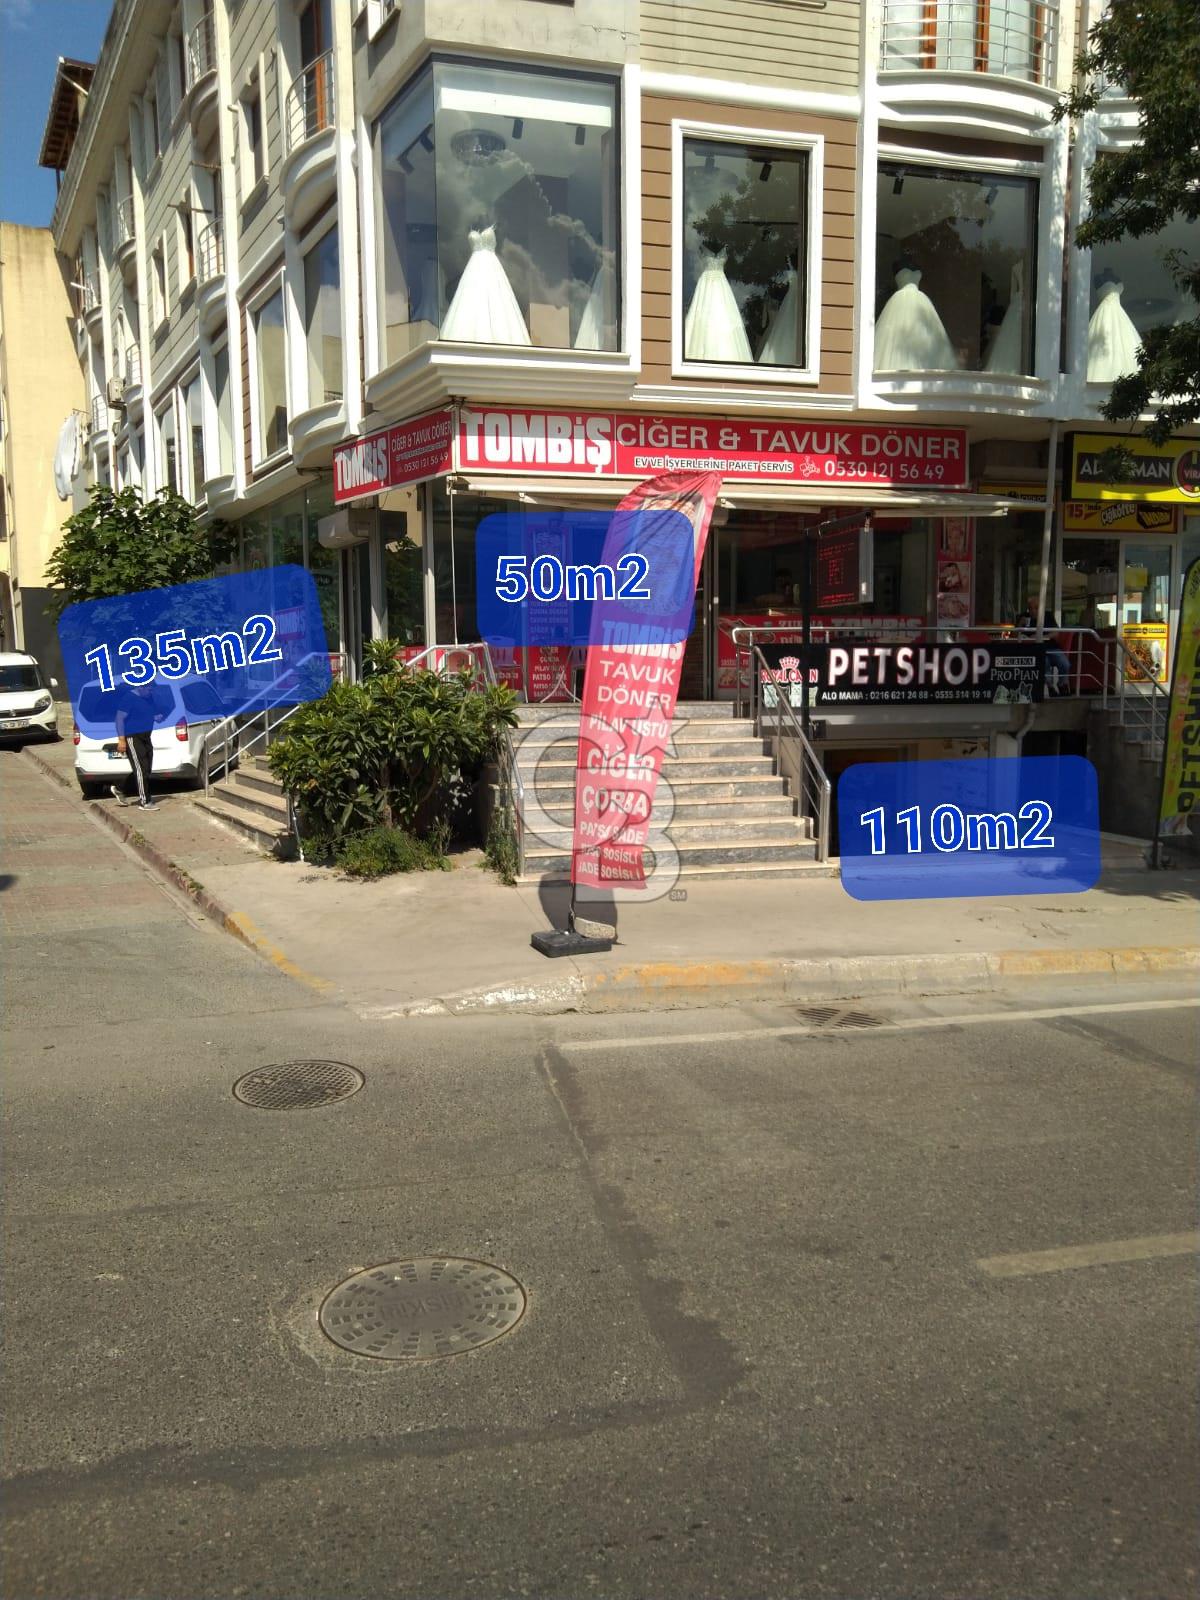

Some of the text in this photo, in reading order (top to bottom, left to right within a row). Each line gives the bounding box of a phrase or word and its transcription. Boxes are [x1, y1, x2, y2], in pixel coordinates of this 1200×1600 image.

[460, 412, 612, 473] TOMBİŞ
[616, 420, 960, 460] CİĞER & TAVUK DÖNER
[335, 437, 388, 492] TOMBİŞ
[634, 455, 795, 473] EV VE İŞYERLERİNE PAKET SERVİS
[824, 460, 945, 480] 0530 121 56 49
[602, 620, 687, 665] TOMBİŞ
[600, 660, 676, 685] TAVUK
[828, 647, 991, 686] PETSHOP
[597, 684, 672, 710] DÖNER
[821, 691, 837, 701] ALO
[838, 691, 864, 701] MAMA
[869, 690, 890, 700] 0216
[890, 690, 905, 700] 621
[907, 690, 917, 699] 24
[590, 712, 630, 734] PİLAV
[587, 744, 656, 782] CİĞER
